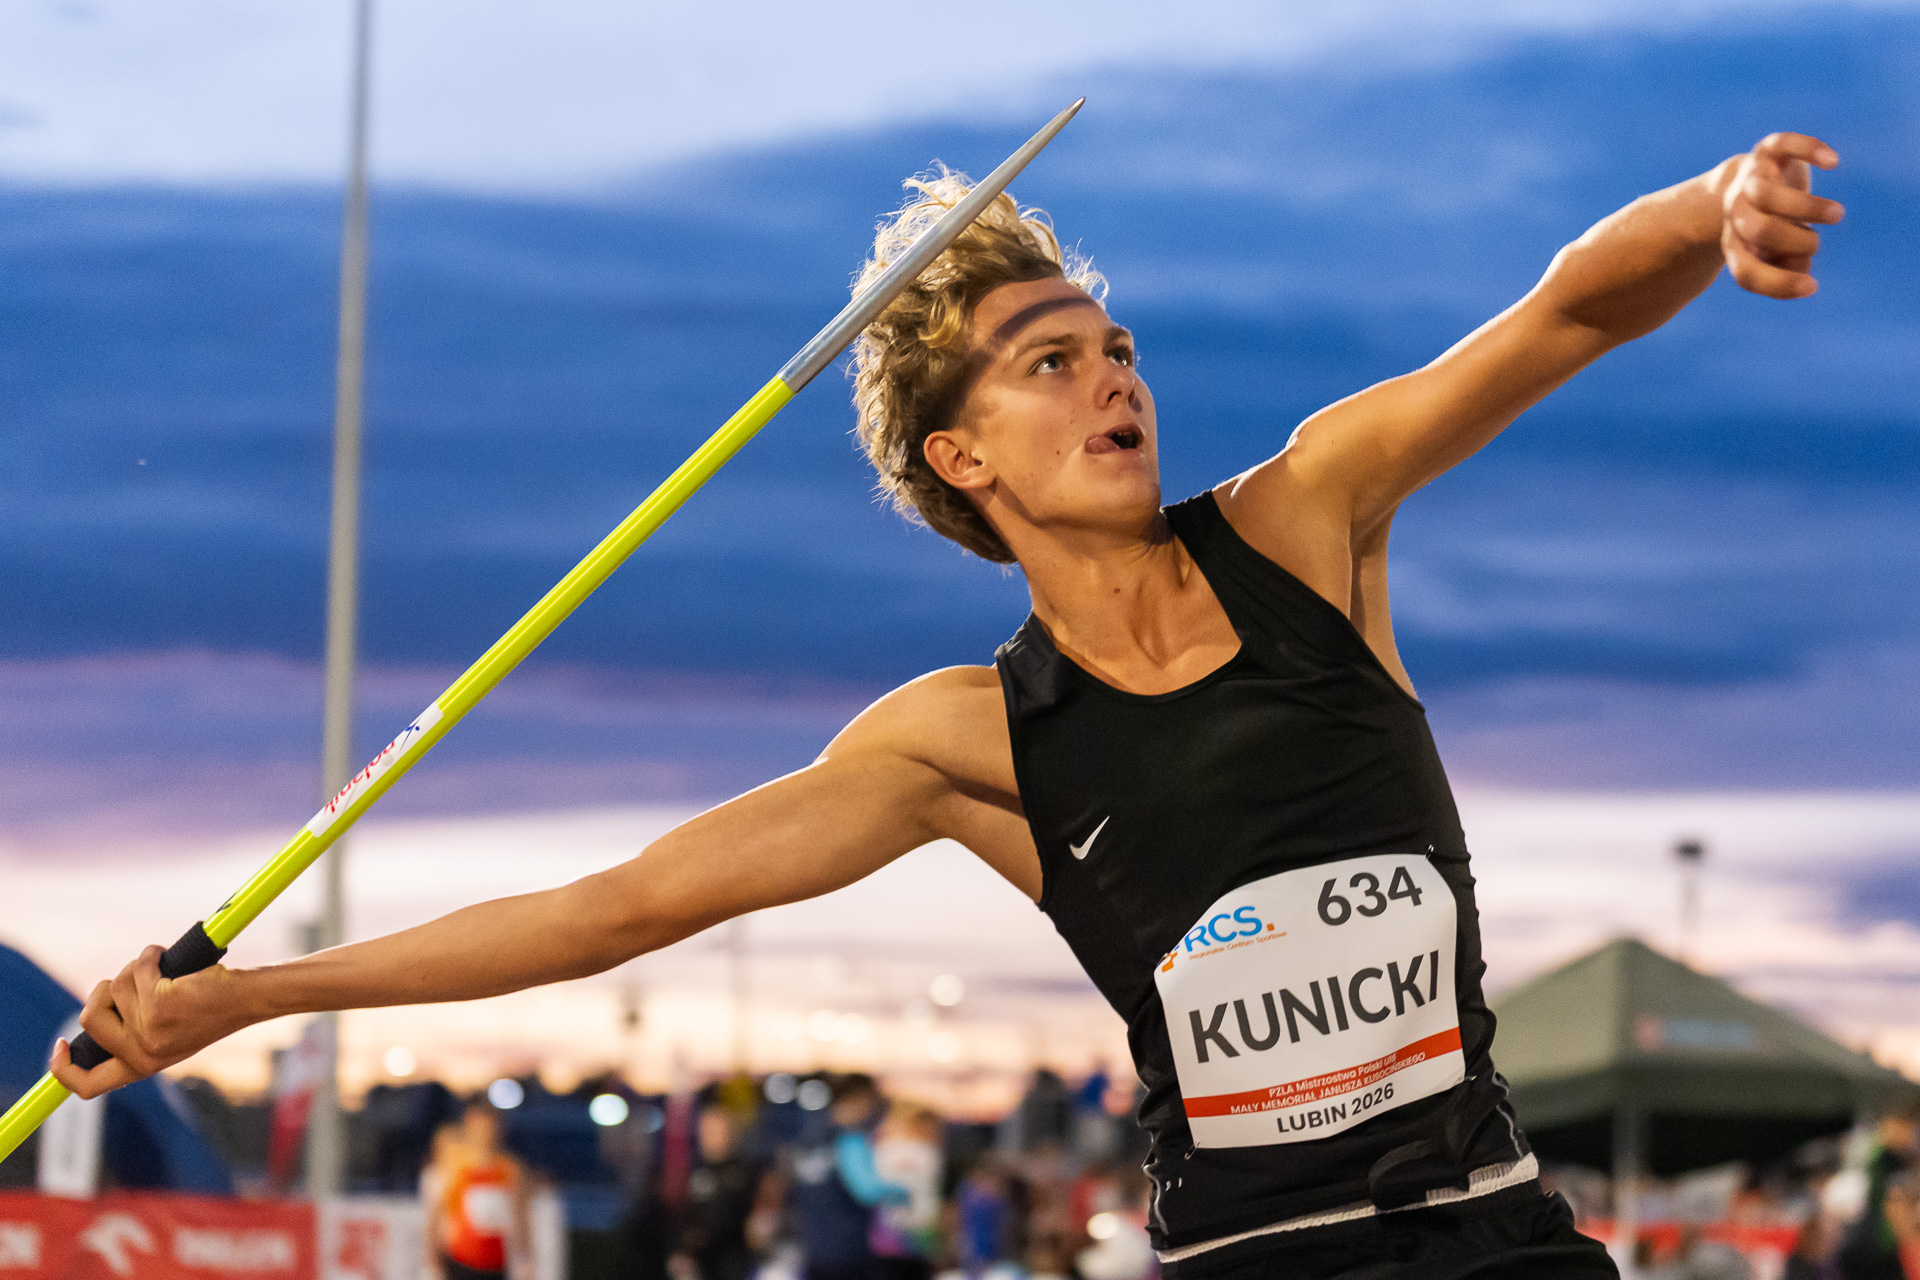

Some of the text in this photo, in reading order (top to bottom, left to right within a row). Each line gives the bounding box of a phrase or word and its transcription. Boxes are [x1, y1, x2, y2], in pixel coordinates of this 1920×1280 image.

[1317, 866, 1422, 926] 634
[1188, 949, 1439, 1064] KUNICKI
[1230, 1102, 1259, 1115] MAŁY
[1261, 1090, 1317, 1110] MEMORIAŁ
[1319, 1078, 1363, 1099] JANUSZA
[1295, 1071, 1357, 1092] Mistrzostwa
[1358, 1060, 1383, 1076] Polski
[1276, 1082, 1395, 1133] LUBIN 2026
